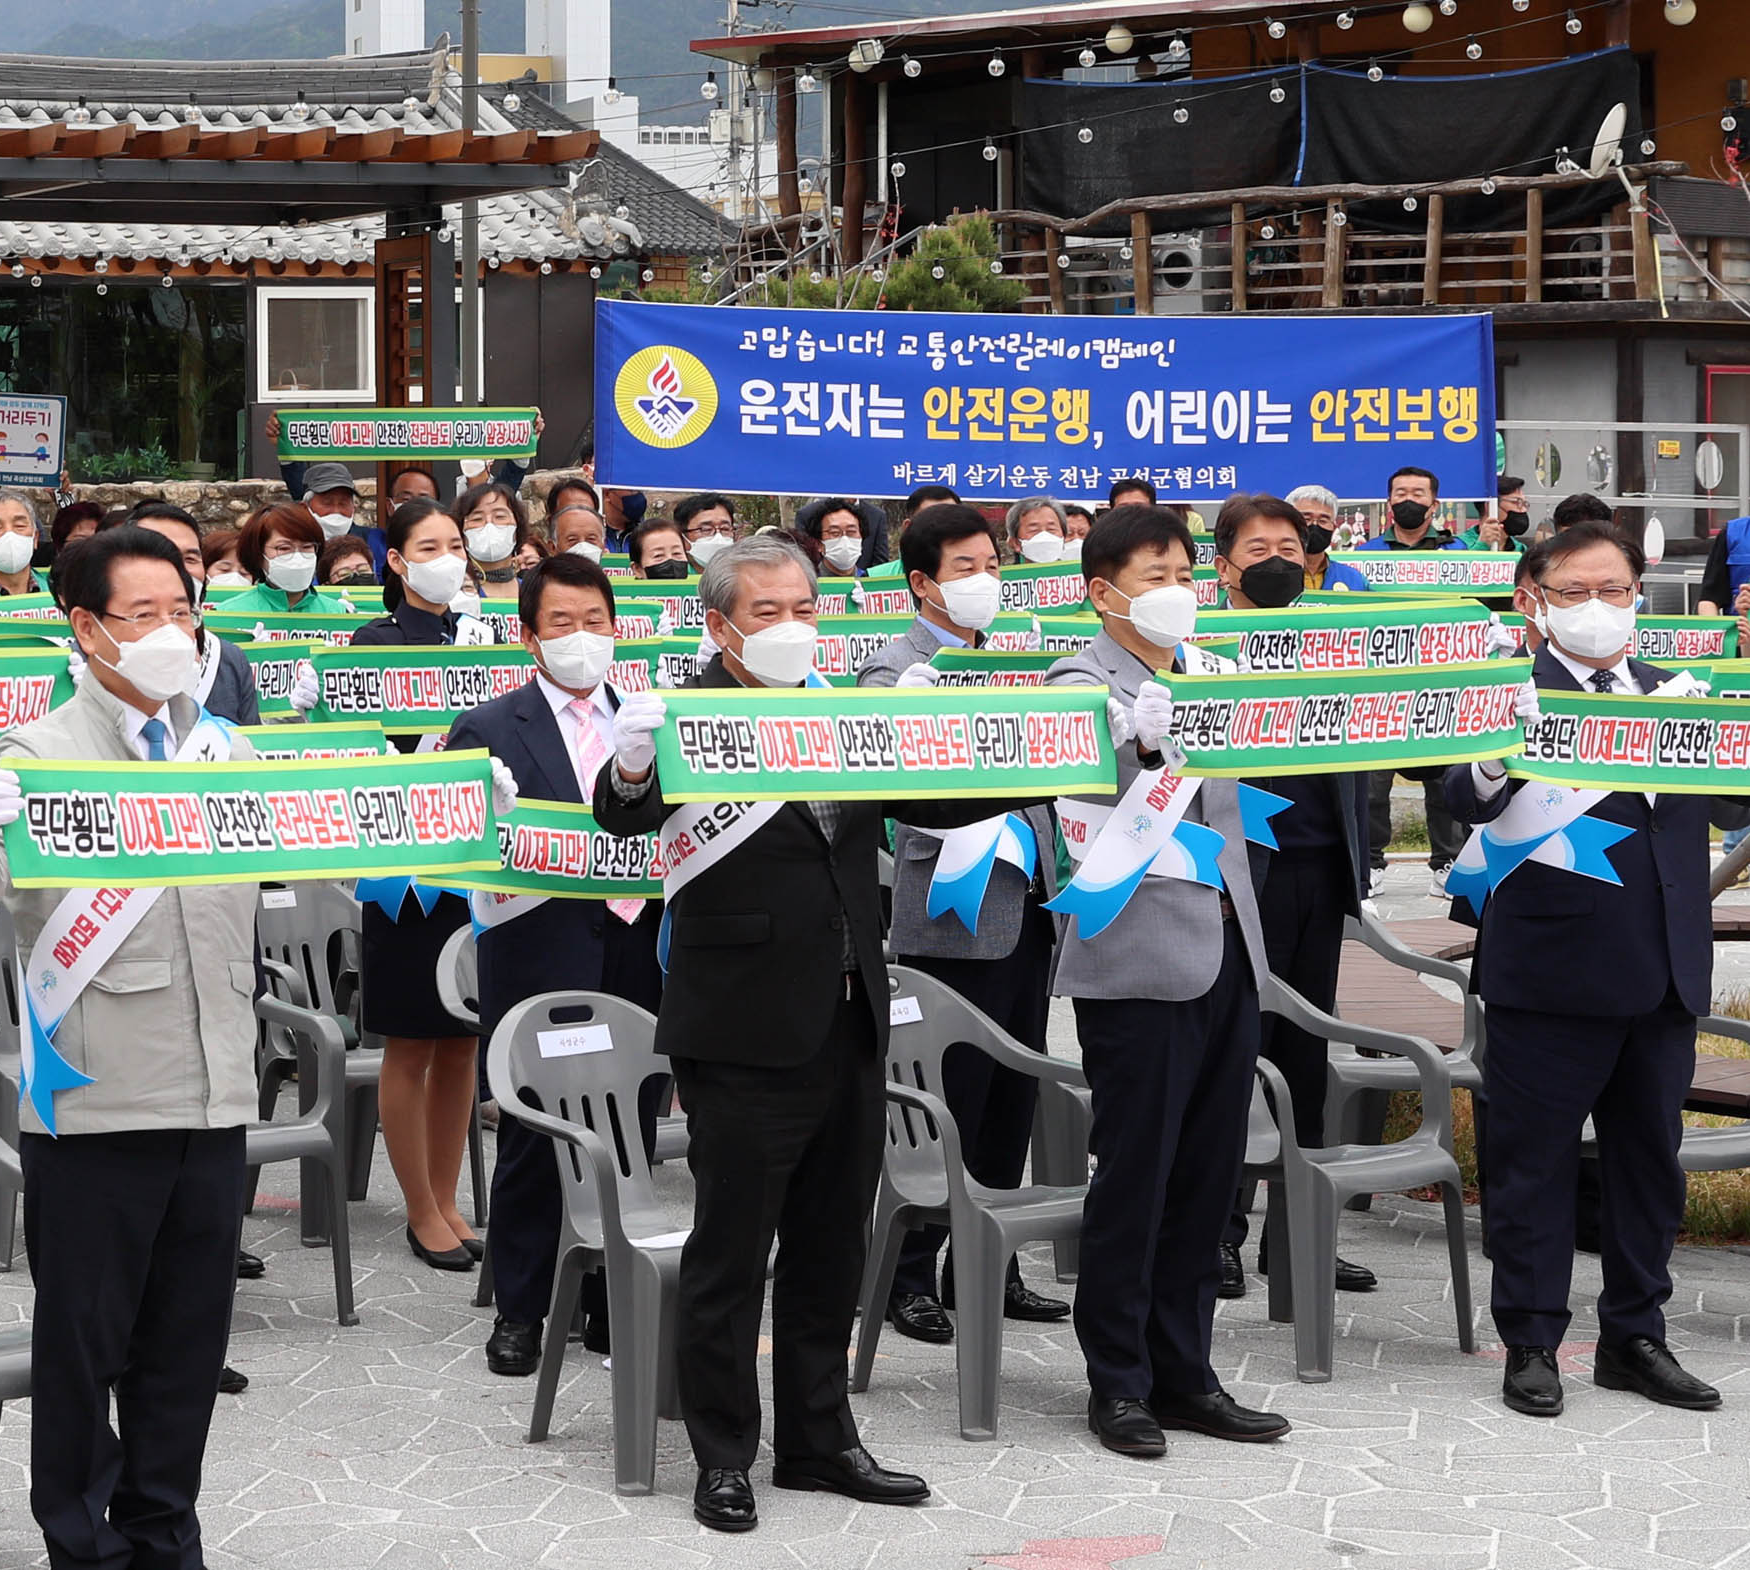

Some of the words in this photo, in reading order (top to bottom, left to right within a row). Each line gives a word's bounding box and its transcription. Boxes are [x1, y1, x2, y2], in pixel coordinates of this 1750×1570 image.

[739, 326, 884, 361] 고맙습니다!
[289, 422, 329, 445] 무단횡단
[331, 422, 374, 445] 이제그만!
[377, 422, 407, 445] 안전한
[410, 422, 452, 445] 전라남도!
[455, 421, 484, 445] 우리가
[486, 422, 530, 445] 앞장서자!
[739, 378, 905, 440] 운전자는
[923, 386, 1104, 449] 안전운행,
[1126, 390, 1292, 445] 어린이는
[1310, 385, 1479, 443] 안전보행
[893, 463, 956, 487] 바르게
[964, 464, 1051, 488] 살기운동
[1059, 466, 1102, 489] 전남
[1365, 562, 1394, 584] 안전한
[1397, 562, 1437, 583] 전라남도!
[1440, 561, 1469, 584] 우리가
[1470, 561, 1514, 583] 앞장서자!
[1002, 582, 1035, 608] 우리가
[1250, 633, 1297, 671] 안전한
[1300, 630, 1366, 668] 전라남도!
[1369, 627, 1415, 666] 우리가
[1641, 630, 1673, 656] 우리가
[260, 663, 294, 697] 우리가
[325, 671, 381, 709] 무단횡단
[383, 669, 445, 710] 이제그만!
[446, 667, 487, 707] 안전한
[1231, 700, 1297, 747] 이제그만!
[1299, 697, 1346, 743] 안전한
[1347, 693, 1410, 741] 전라남도!
[1412, 691, 1455, 737] 우리가
[679, 719, 756, 771] 무단횡단
[758, 718, 839, 768] 이제그만!
[840, 718, 893, 767] 안전한
[898, 717, 973, 766] 전라남도!
[975, 716, 1023, 767] 우리가
[1026, 711, 1098, 766] 앞장서자!
[1578, 718, 1654, 763] 이제그만!
[1659, 720, 1712, 764] 안전한
[27, 792, 116, 857] 무단횡단
[119, 792, 210, 853] 이제그만!
[210, 790, 272, 849] 안전한
[274, 789, 357, 845] 전라남도!
[354, 786, 411, 845] 우리가
[412, 780, 485, 841] 앞장서자!
[513, 828, 588, 876] 이제그만!
[593, 835, 646, 878] 안전한
[52, 913, 102, 969] 멈춤
